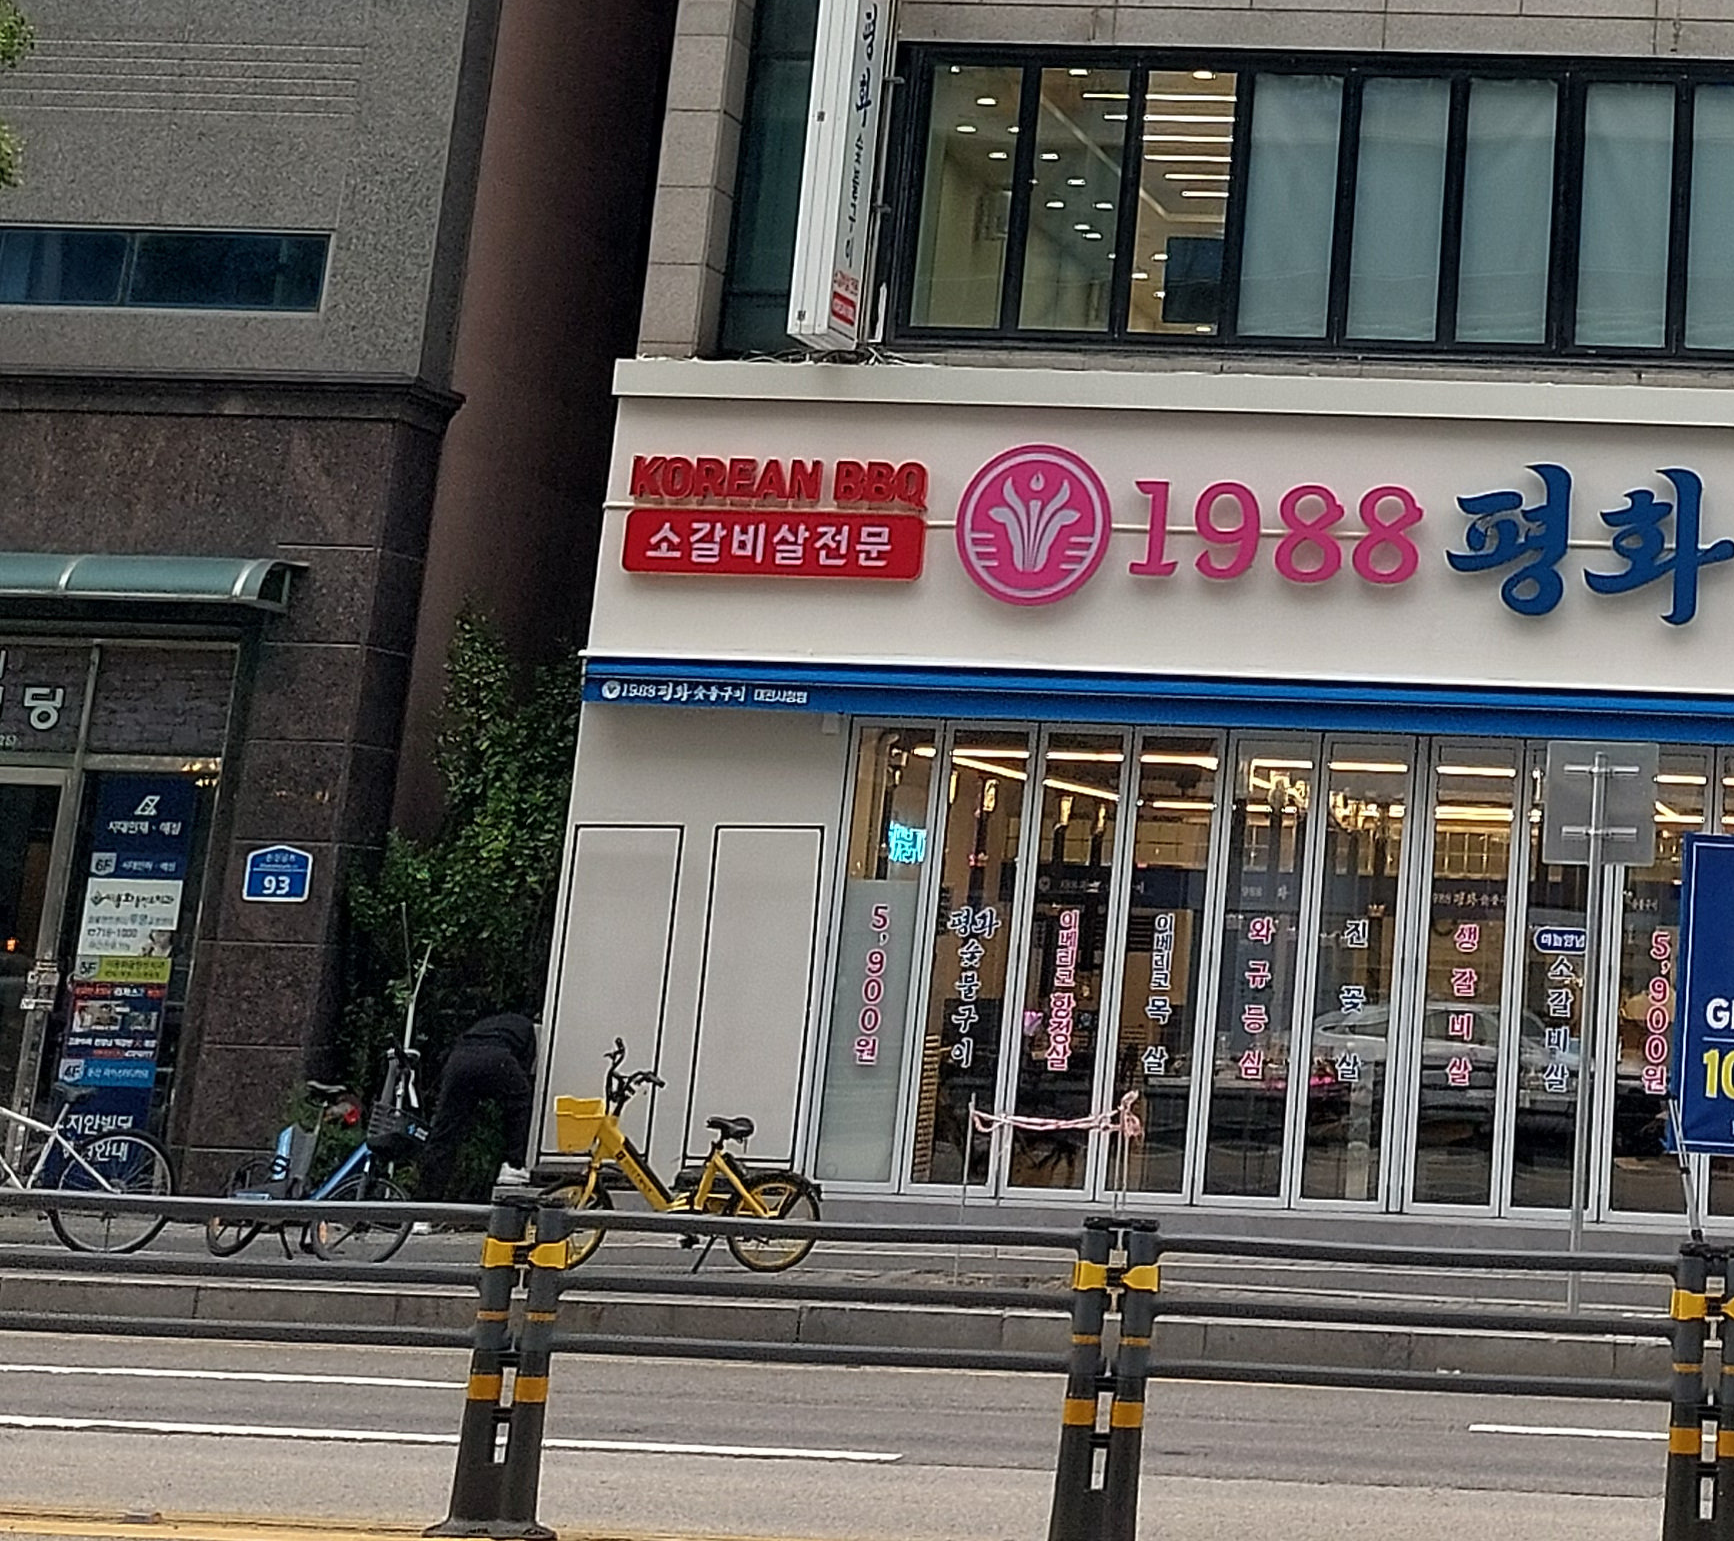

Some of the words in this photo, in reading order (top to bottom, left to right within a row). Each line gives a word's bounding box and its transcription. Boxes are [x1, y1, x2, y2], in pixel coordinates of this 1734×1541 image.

[628, 454, 824, 505] KOREAN
[832, 459, 930, 510] BBQ
[644, 521, 893, 570] 소갈비살전문
[1127, 479, 1425, 586] 1988
[262, 875, 291, 895] 93
[853, 904, 891, 1067] 5,900원
[1238, 916, 1278, 1081] 와규등심
[1446, 922, 1481, 1088] 생갈비살
[1543, 954, 1576, 1093] 소갈비살
[1641, 929, 1672, 1096] 5,900원
